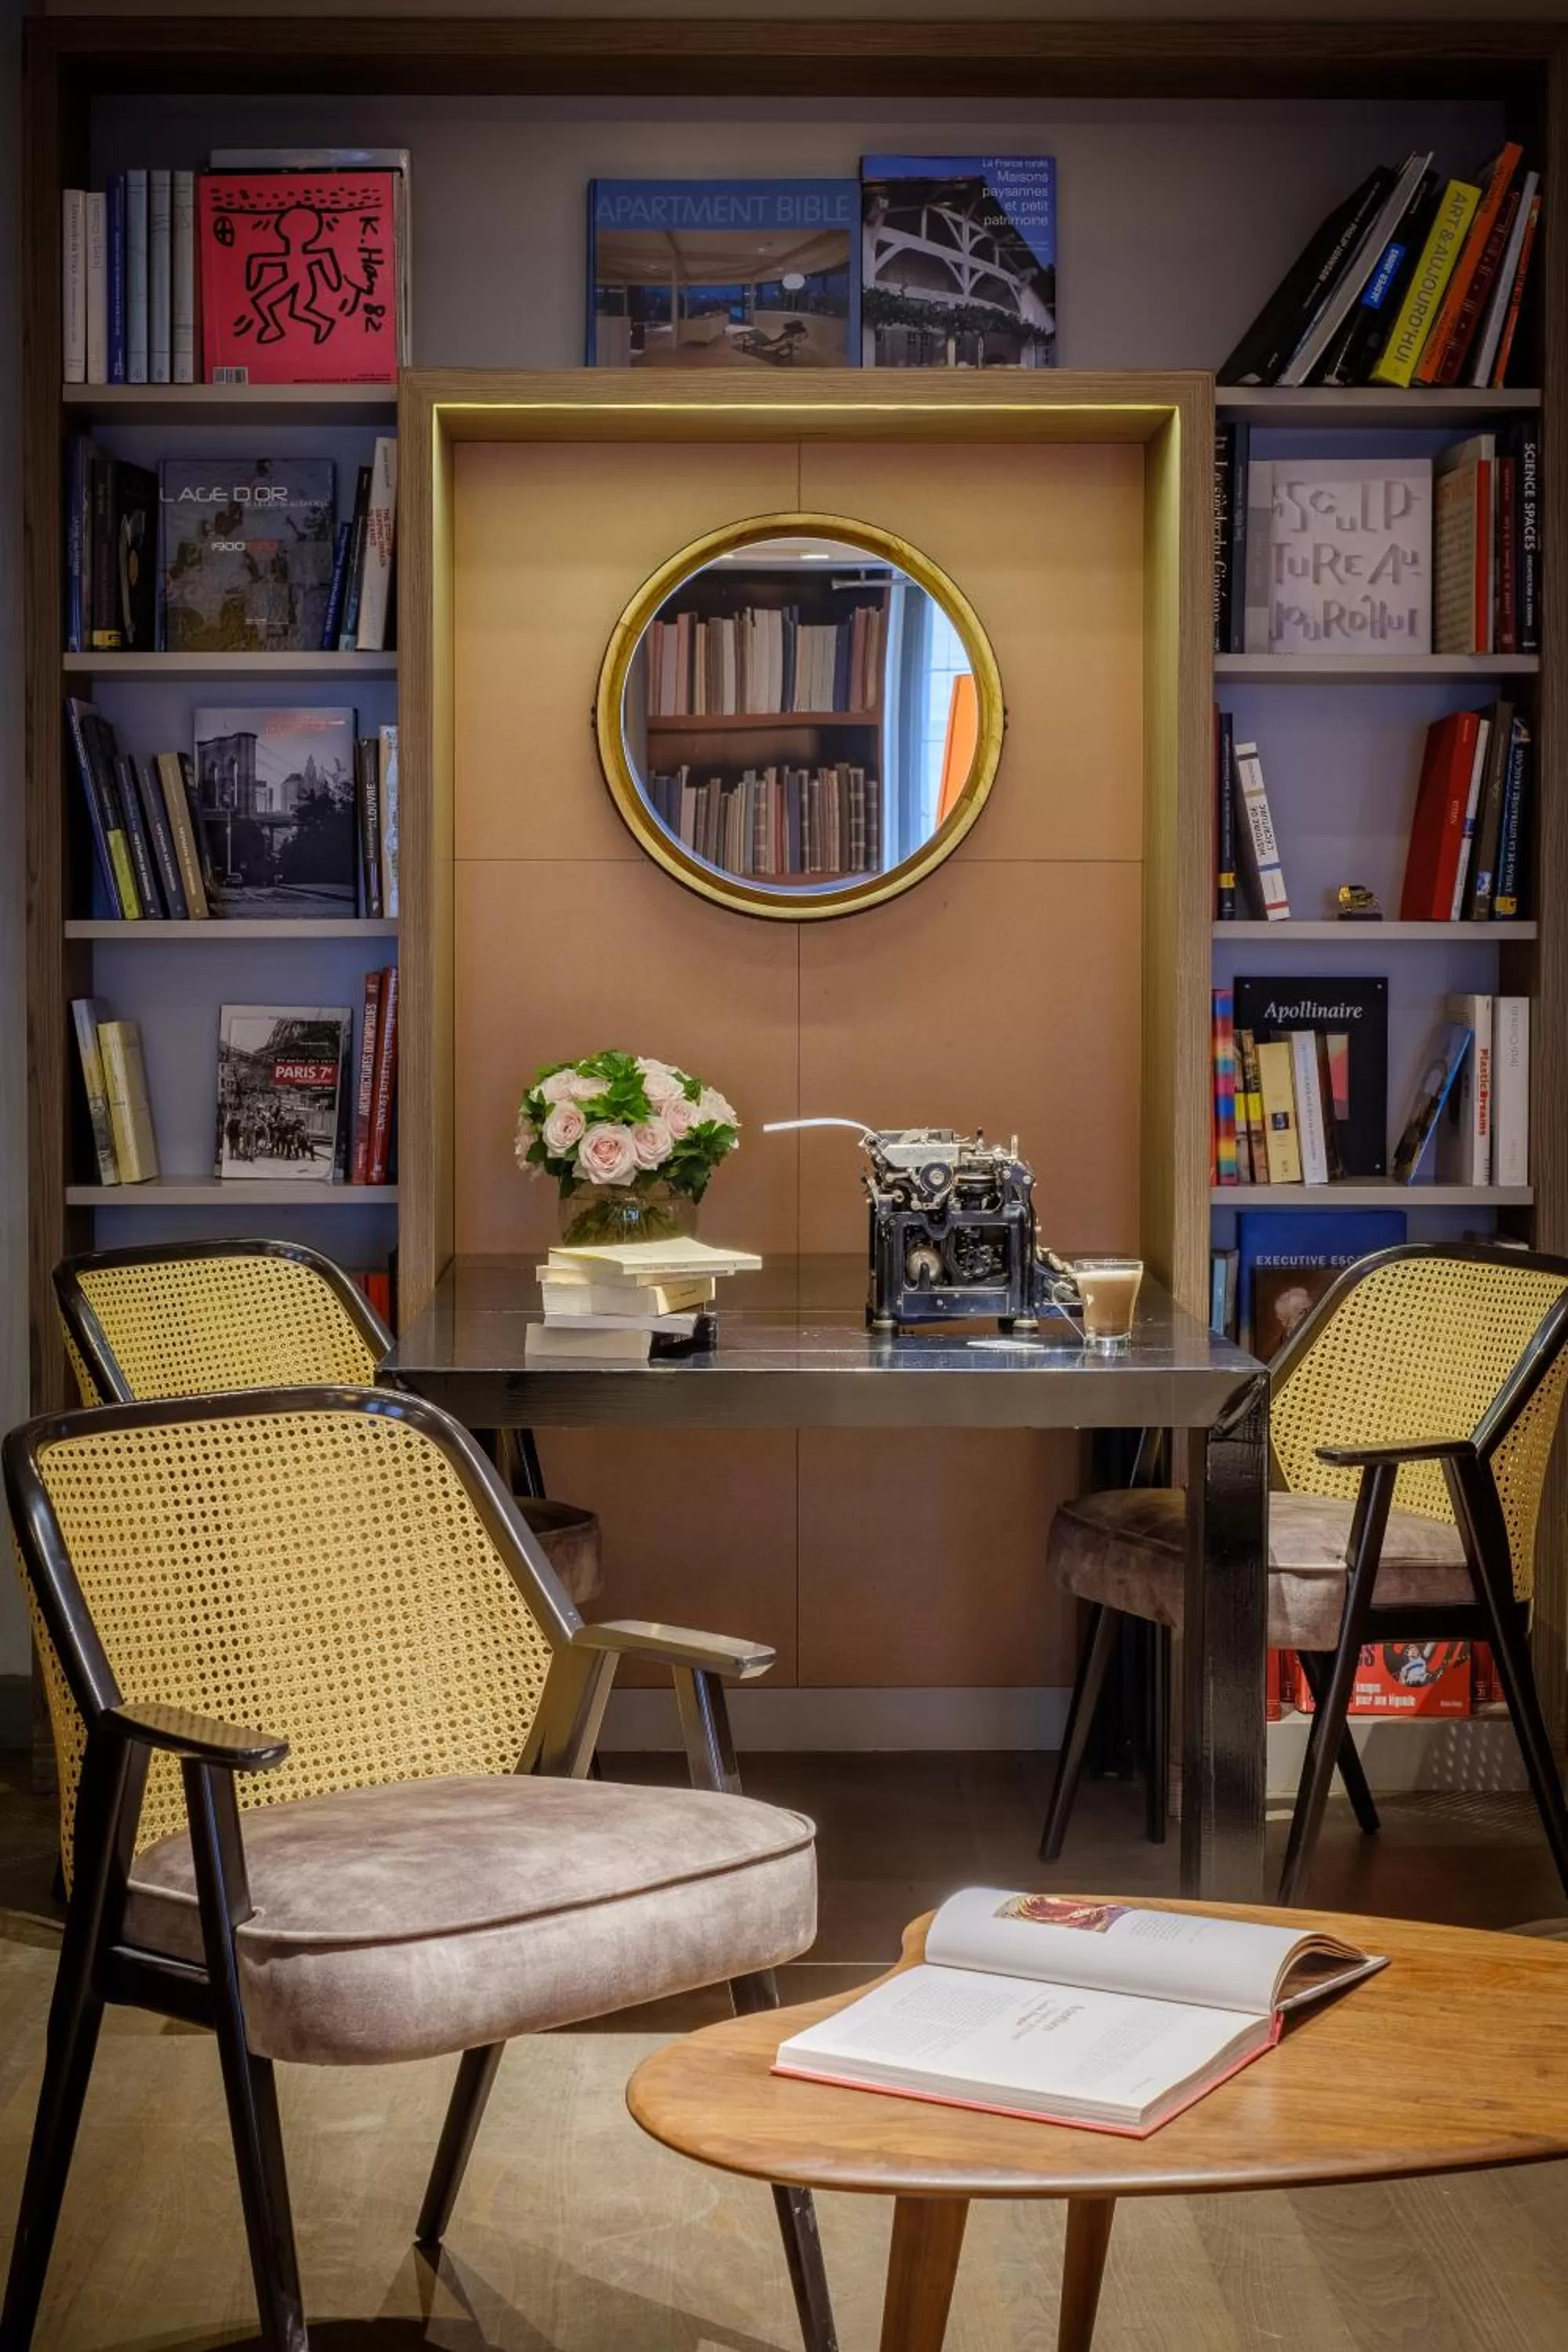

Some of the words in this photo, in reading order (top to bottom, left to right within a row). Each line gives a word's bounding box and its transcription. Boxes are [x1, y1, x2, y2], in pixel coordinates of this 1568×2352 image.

[997, 169, 1048, 183] Maisons
[982, 187, 1048, 199] paysannes
[1004, 200, 1017, 211] et
[1022, 200, 1048, 212] petit
[595, 194, 769, 223] APARTMENT
[776, 194, 851, 223] BIBLE
[984, 214, 1048, 227] patrimoine
[1444, 190, 1470, 229] ART
[1439, 227, 1456, 245] &
[1393, 245, 1450, 365] AUJOURD'HUI
[1523, 442, 1536, 496] SCIENCE
[1523, 503, 1536, 550] SPACES
[368, 782, 377, 821] LOUVRE
[1263, 1000, 1364, 1024] Apollinaire
[364, 1003, 378, 1054] OLYMPIQUES
[275, 1065, 316, 1079] PARIS
[358, 1055, 374, 1116] ARCHITECTURES
[1255, 1255, 1327, 1266] EXECUTIVE
